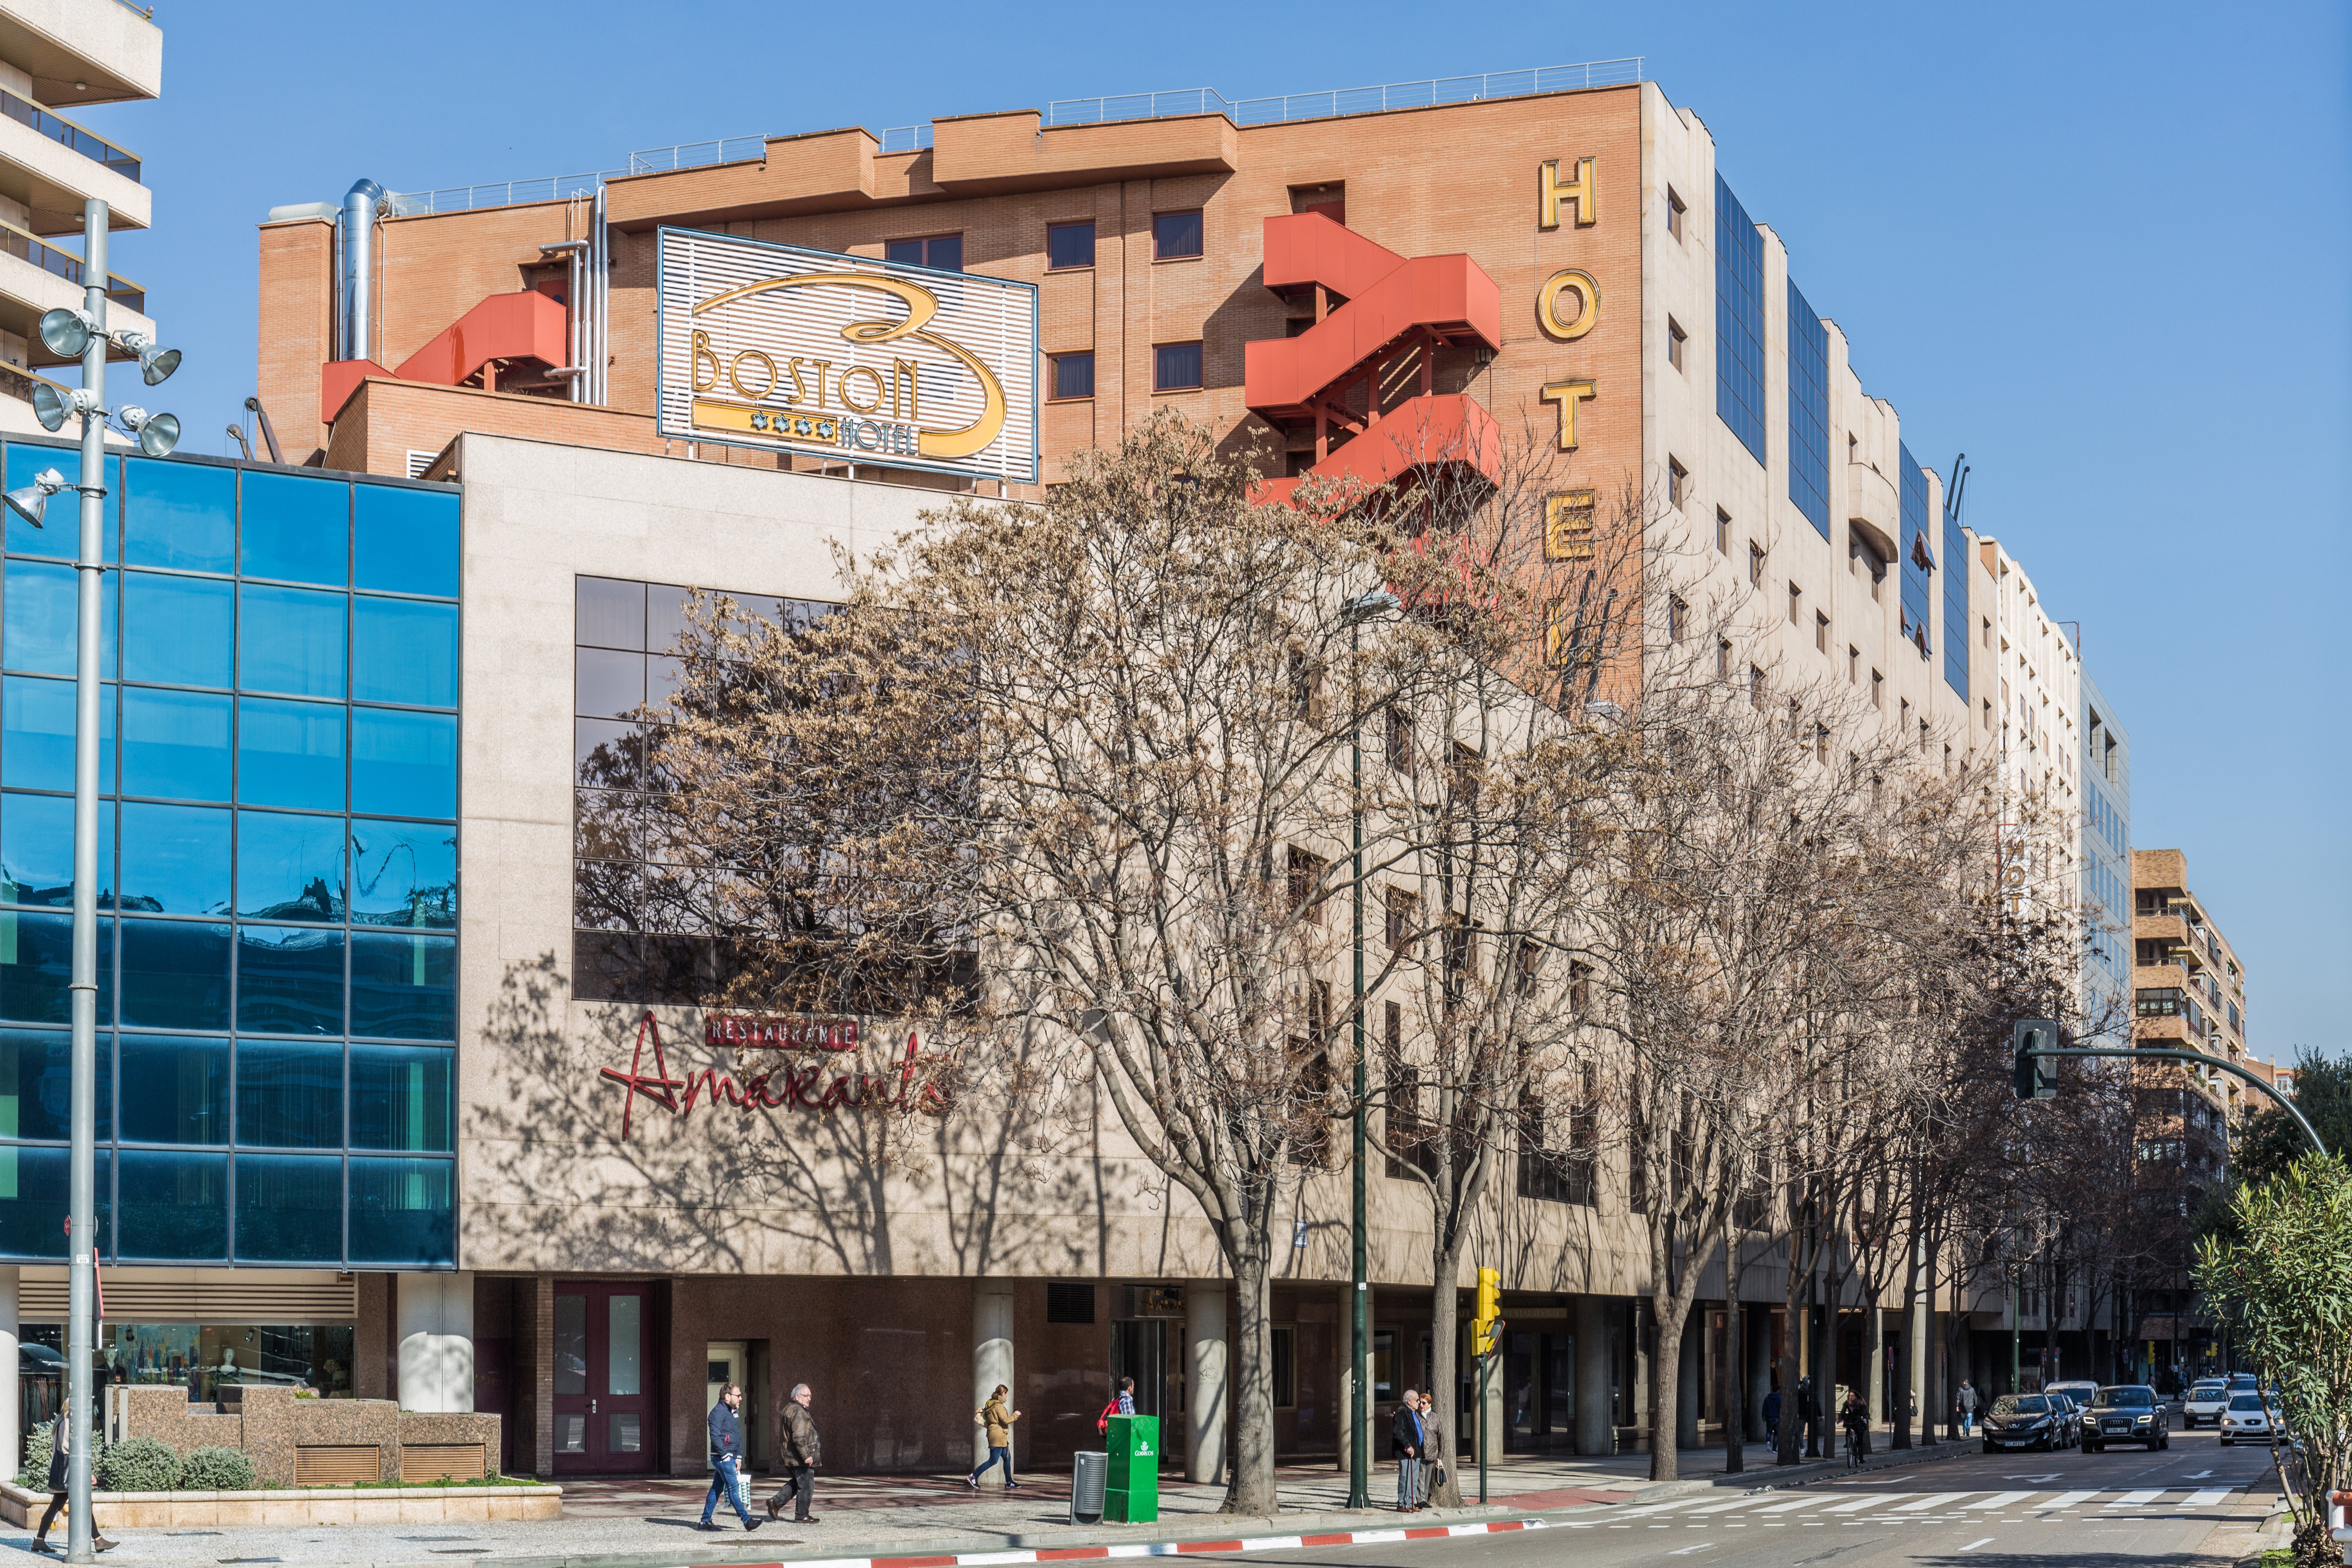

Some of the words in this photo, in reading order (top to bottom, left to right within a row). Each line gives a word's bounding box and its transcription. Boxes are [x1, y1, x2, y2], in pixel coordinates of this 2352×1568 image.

[692, 329, 918, 420] BOSTON
[1538, 156, 1603, 666] HOTEL
[841, 416, 917, 455] HOTEL
